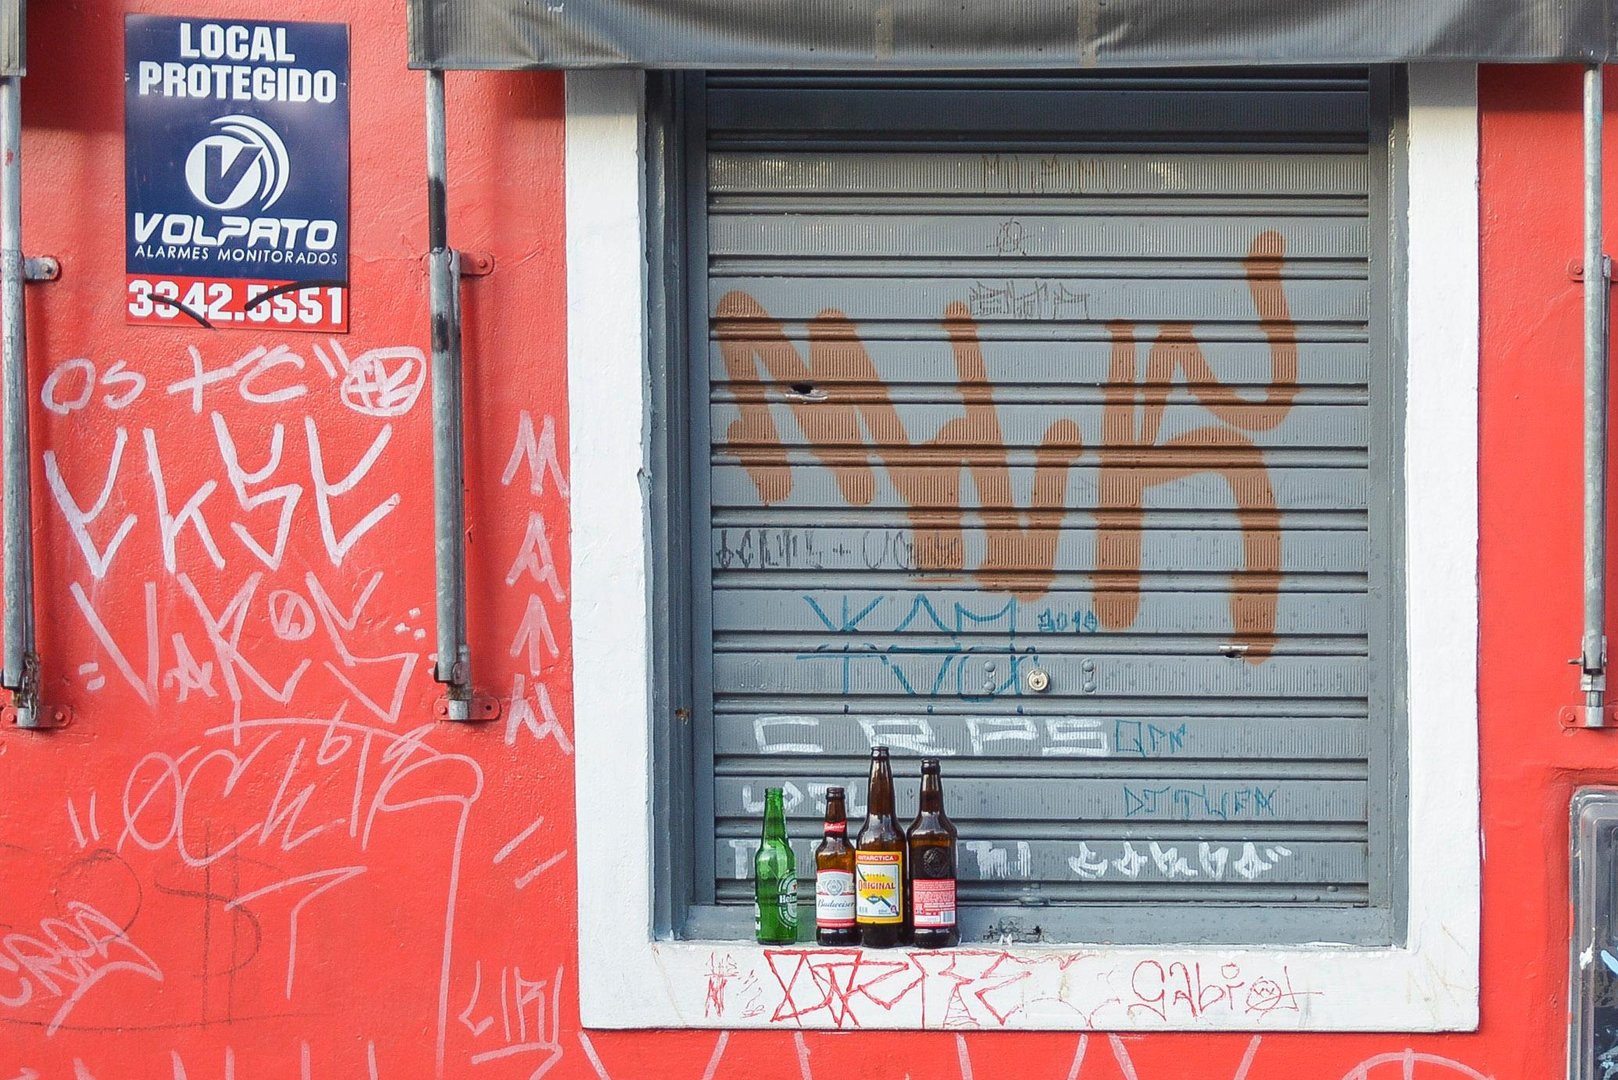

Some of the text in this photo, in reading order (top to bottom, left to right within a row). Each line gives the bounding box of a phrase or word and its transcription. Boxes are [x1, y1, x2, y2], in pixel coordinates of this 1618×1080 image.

[180, 23, 295, 62] LOCAL
[139, 61, 337, 103] PROTEGIDO
[134, 212, 338, 250] VOLPATO
[134, 245, 339, 265] ALARMES MONITORADOS
[128, 279, 342, 324] 3342.5551
[817, 898, 856, 909] Budweiser
[858, 880, 896, 892] ORIGINAL
